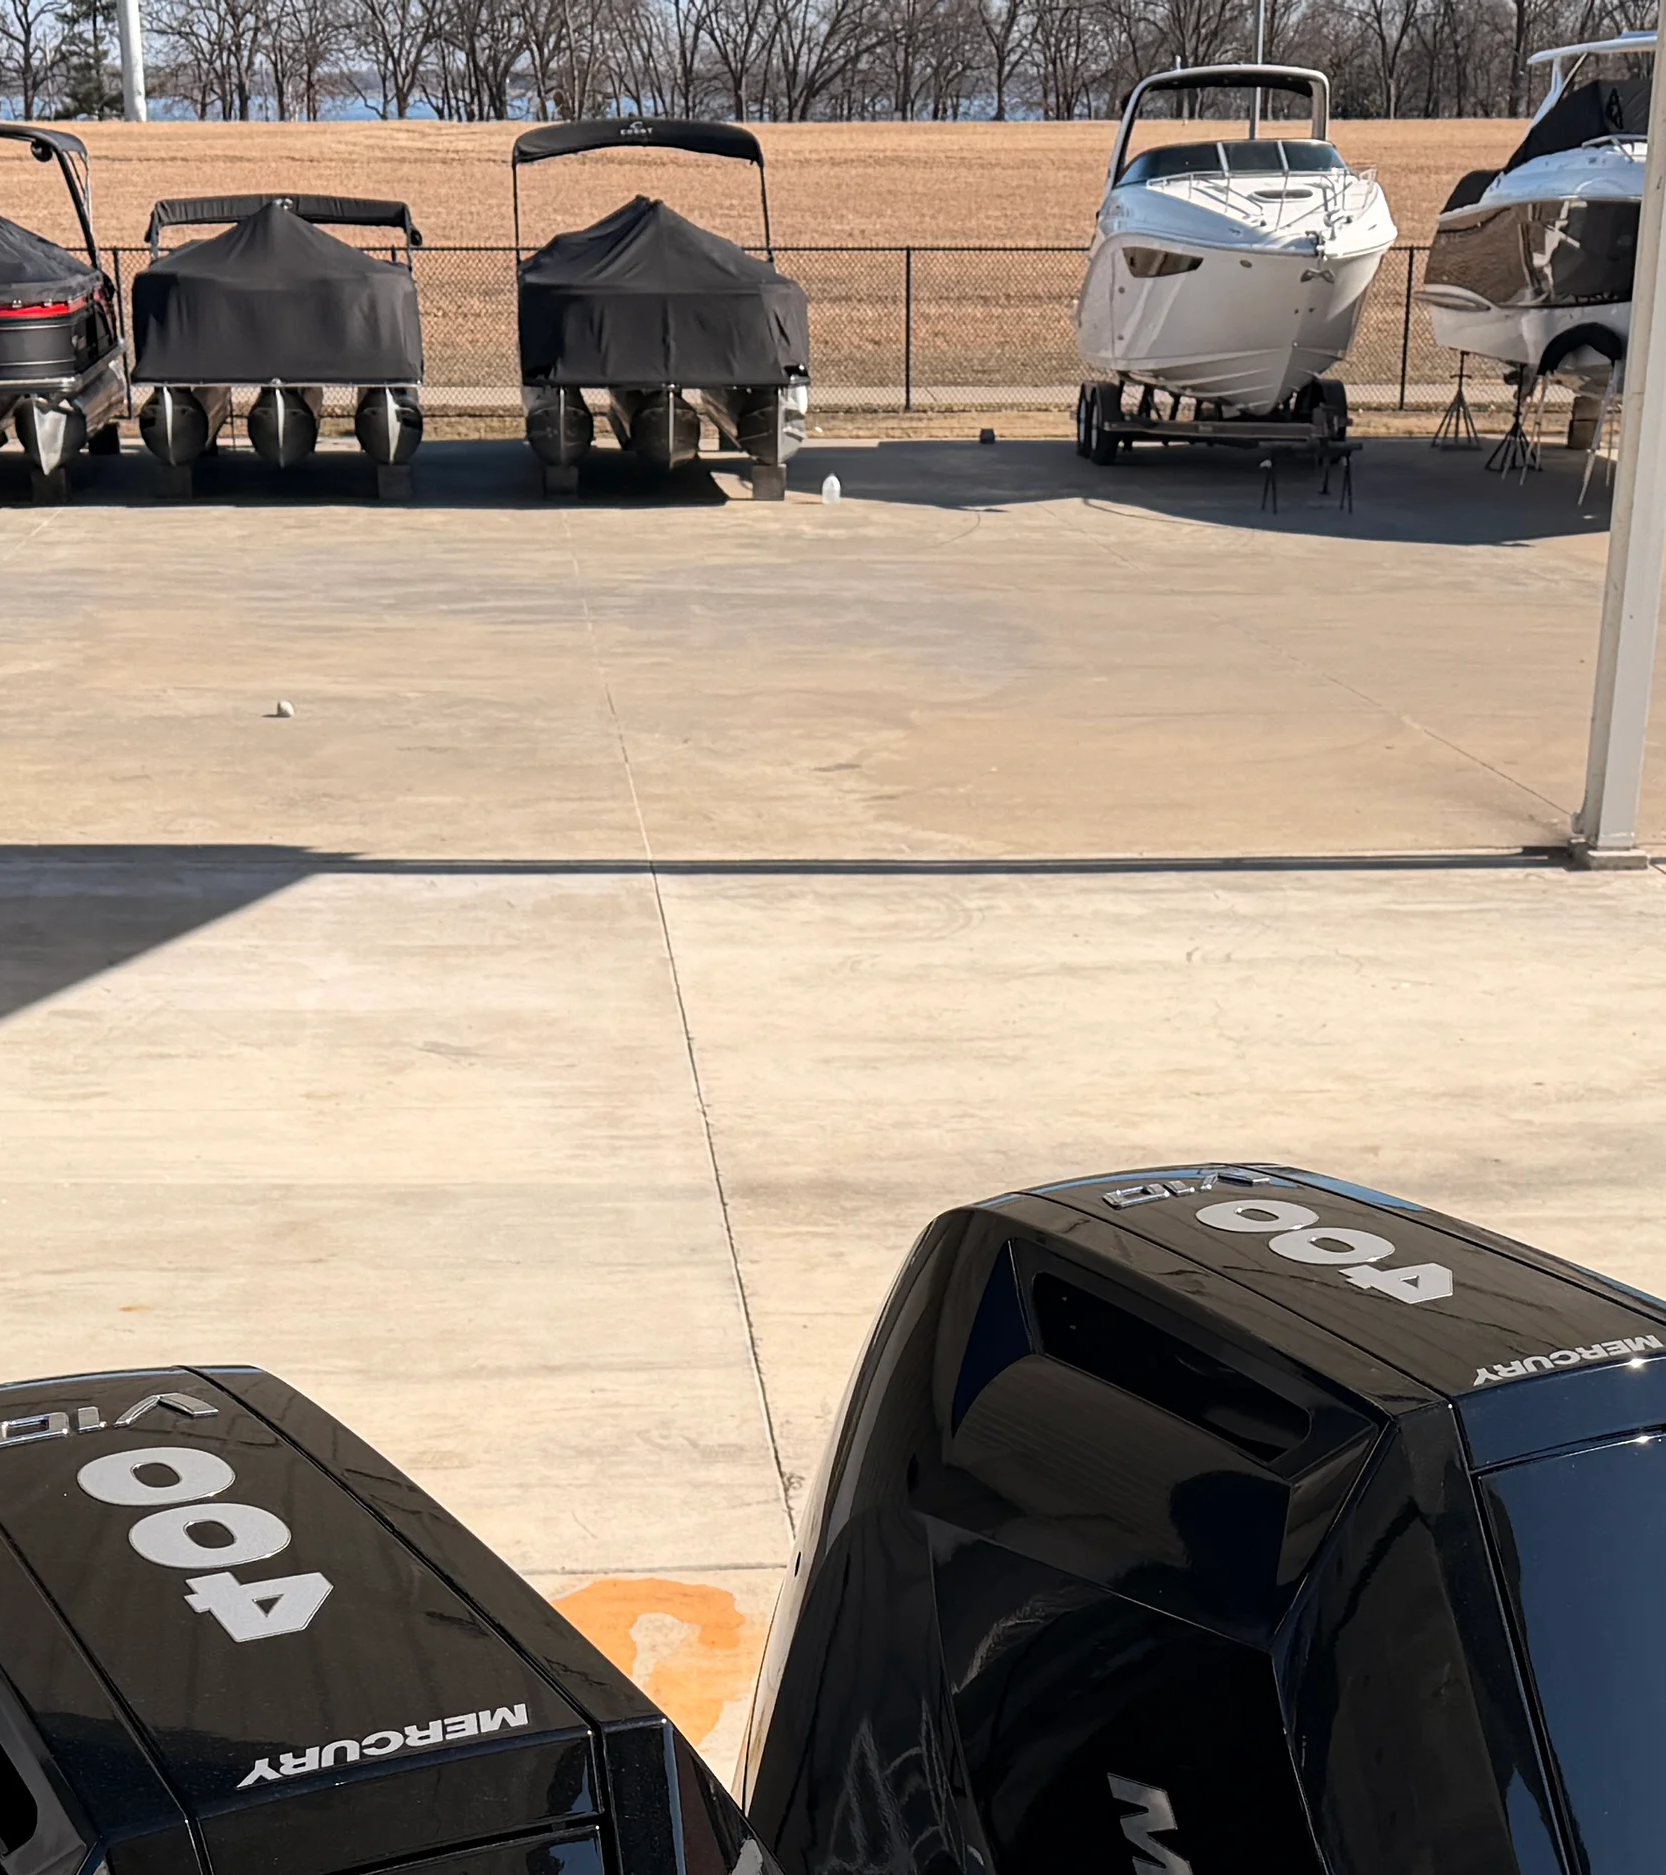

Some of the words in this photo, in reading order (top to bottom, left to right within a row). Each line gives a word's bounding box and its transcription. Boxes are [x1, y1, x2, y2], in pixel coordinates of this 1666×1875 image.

[1101, 1171, 1271, 1211] V10
[1195, 1199, 1453, 1305] 400
[1472, 1333, 1664, 1388] MERCURY
[76, 1446, 334, 1643] 400
[236, 1702, 529, 1791] MERCURY
